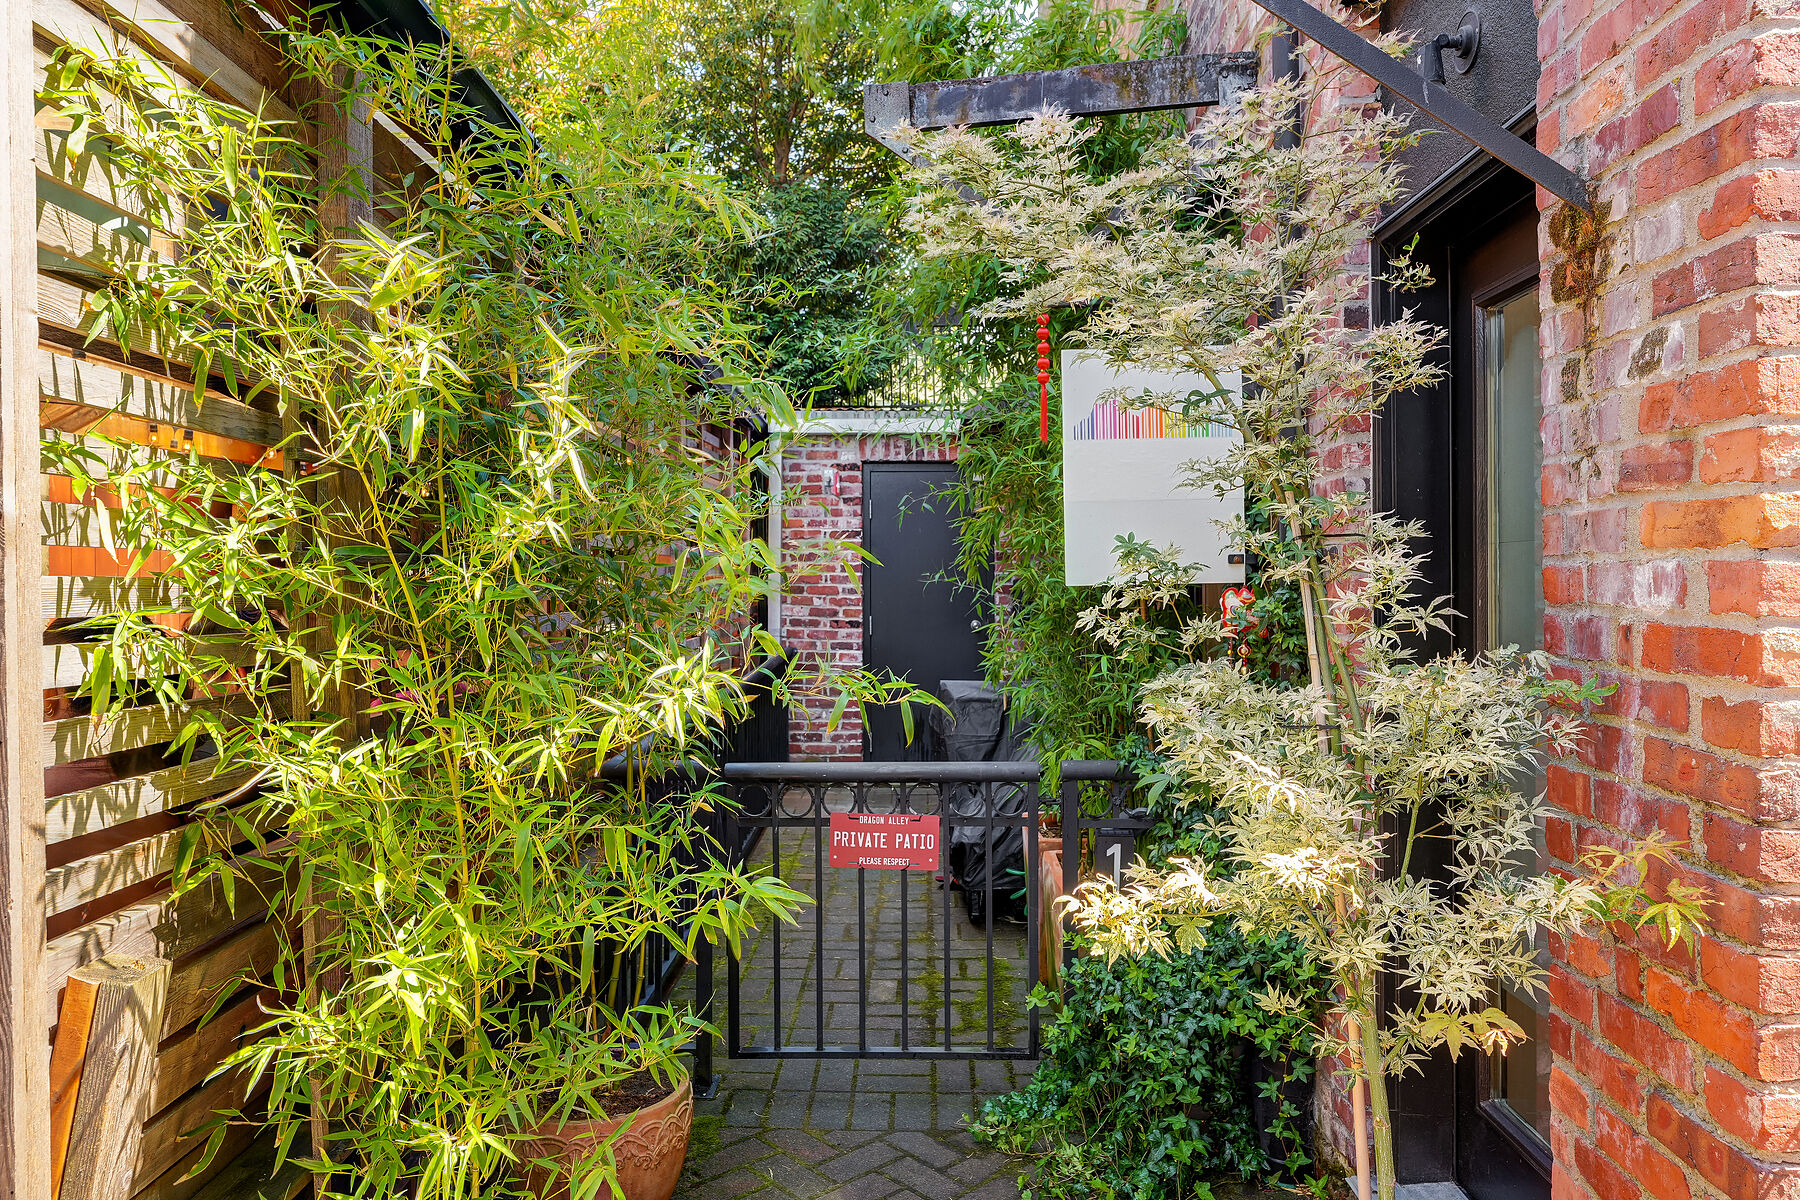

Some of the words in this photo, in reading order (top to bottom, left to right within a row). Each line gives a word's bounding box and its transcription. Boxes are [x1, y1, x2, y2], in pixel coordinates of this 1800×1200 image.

[859, 816, 885, 825] DRAGON
[888, 816, 909, 825] ALLEY
[833, 831, 888, 848] PRIVATE
[895, 833, 934, 850] PATIO
[858, 857, 882, 865] PLEASE
[883, 858, 910, 866] RESPECT
[1106, 843, 1122, 893] 1
